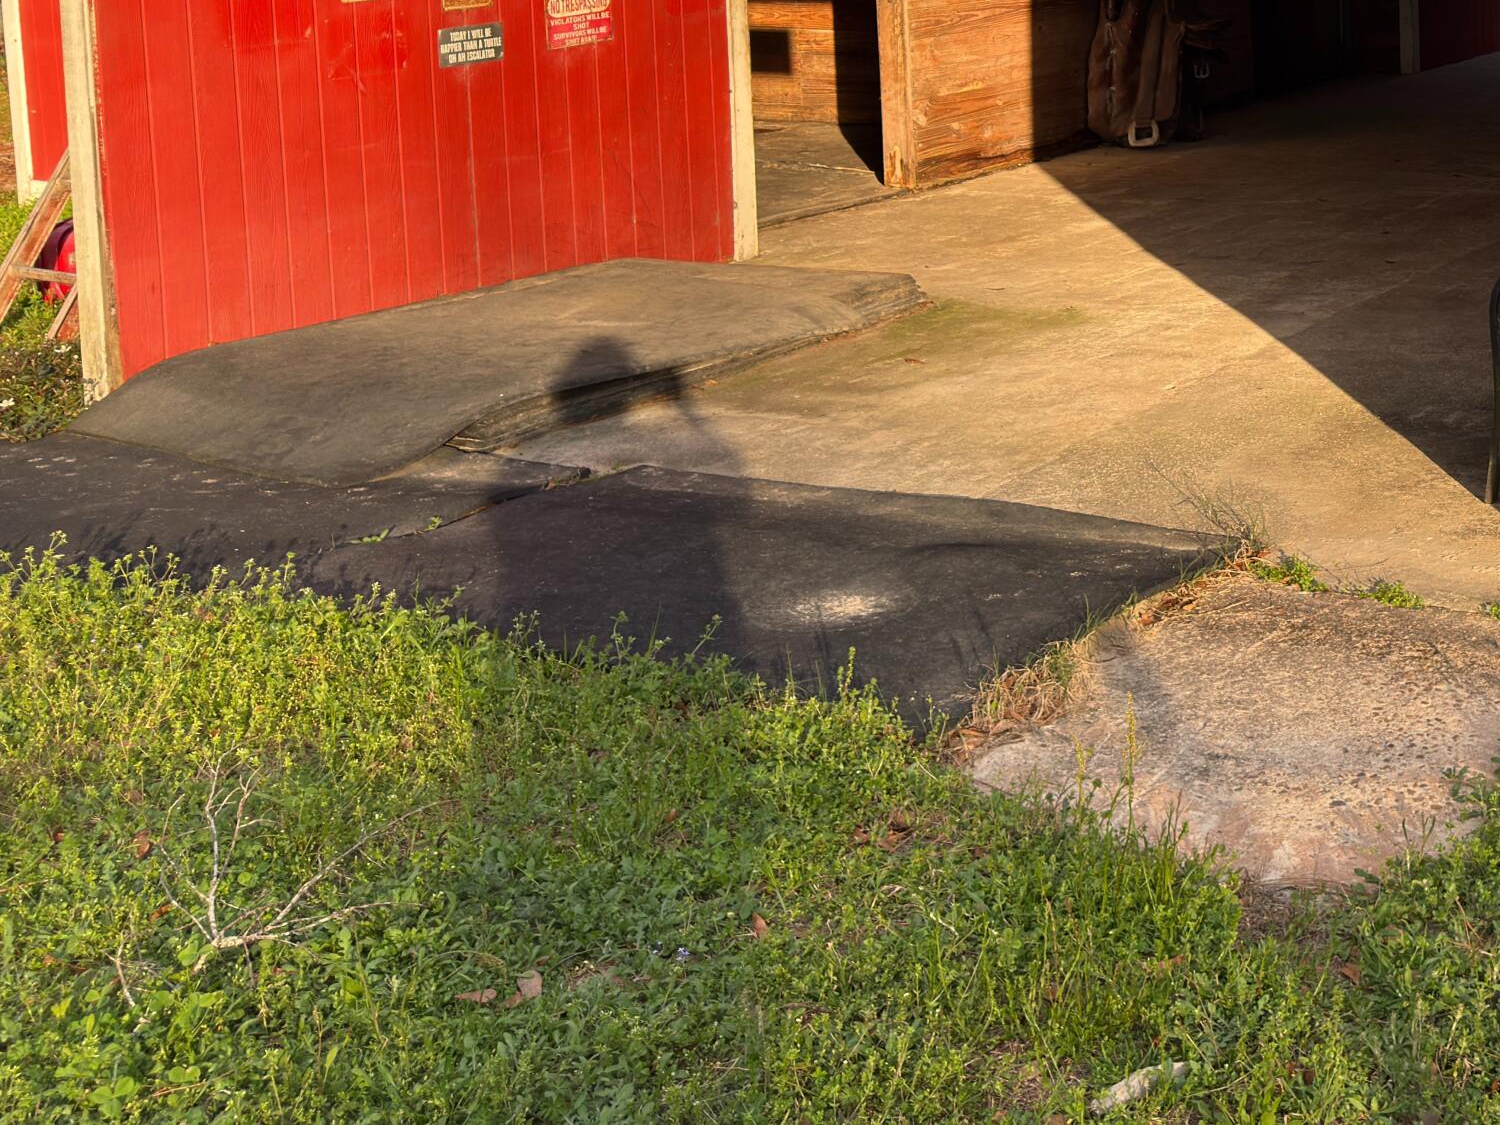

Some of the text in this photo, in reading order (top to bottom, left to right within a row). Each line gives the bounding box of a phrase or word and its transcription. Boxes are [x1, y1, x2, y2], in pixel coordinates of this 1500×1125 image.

[550, 0, 560, 14] NO
[550, 15, 586, 26] VIOLATORS
[586, 13, 600, 22] WILL
[573, 21, 590, 31] SHOT
[450, 28, 492, 42] TODAY I WILL BE
[440, 36, 502, 54] HAPPIER THAN A TURTLE
[448, 48, 496, 64] ON AN ESCALATOR
